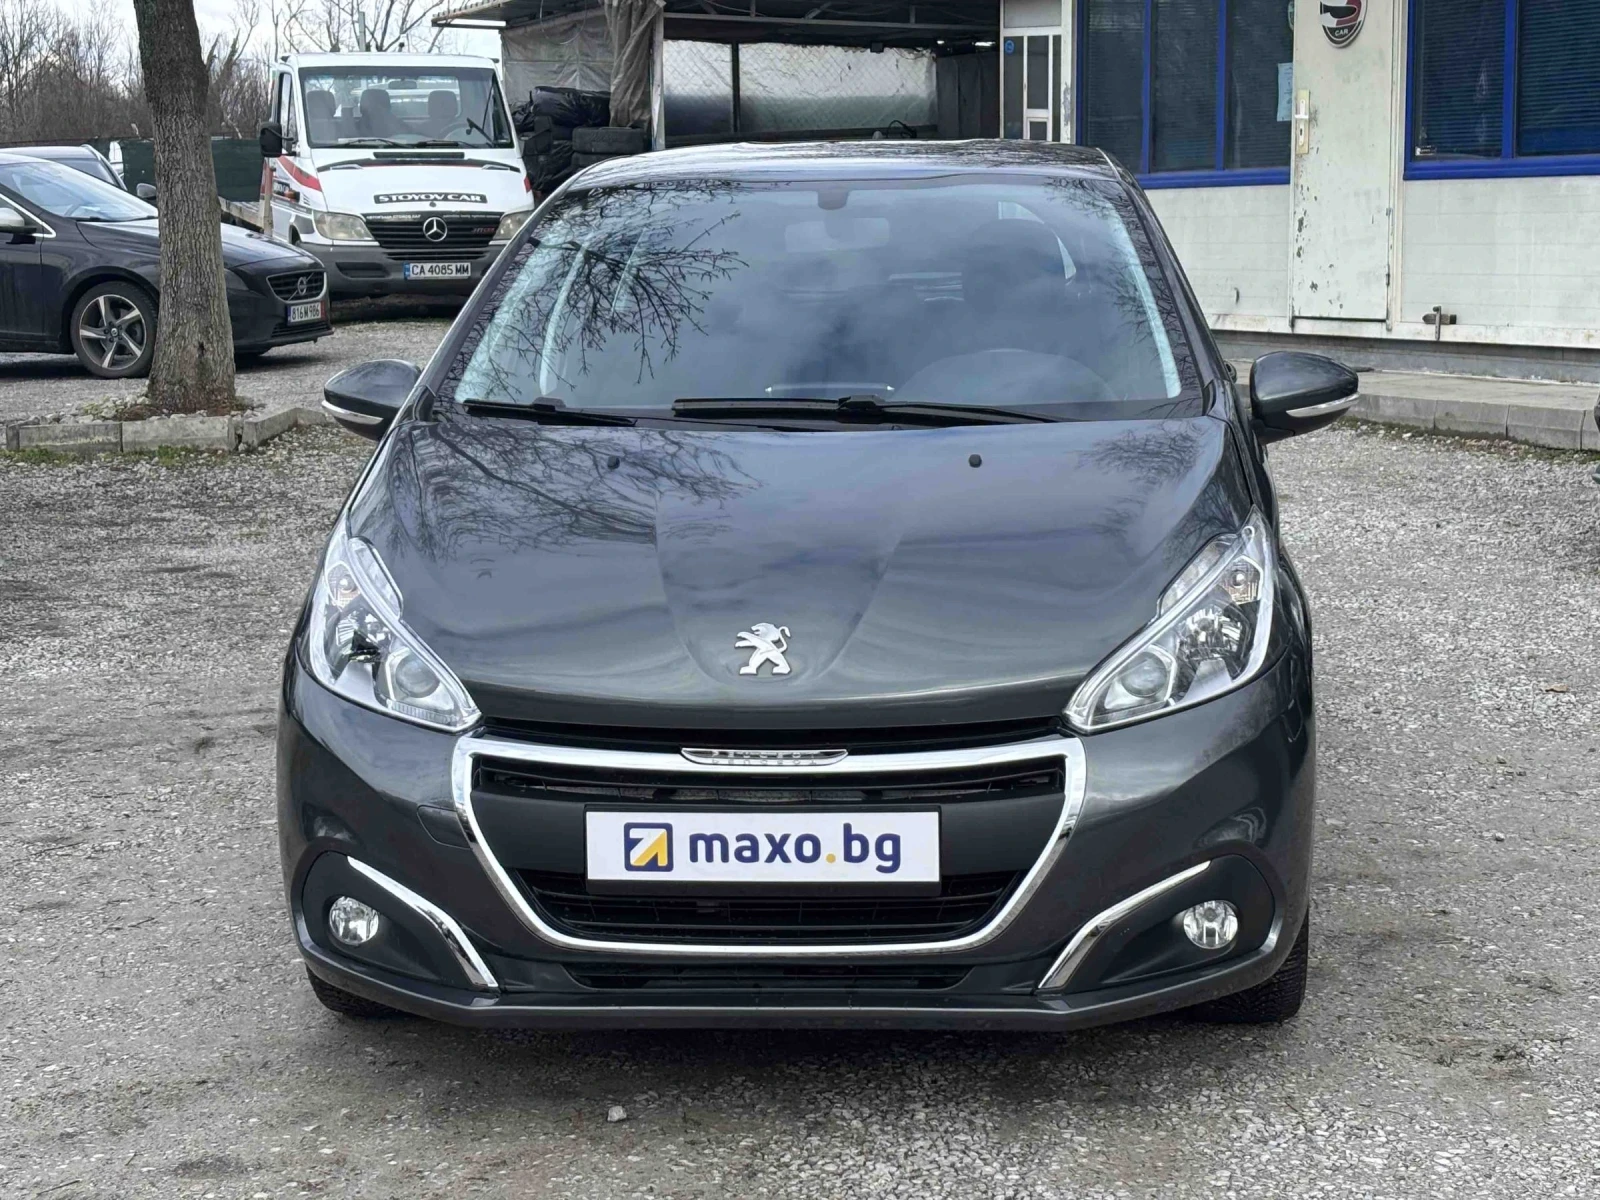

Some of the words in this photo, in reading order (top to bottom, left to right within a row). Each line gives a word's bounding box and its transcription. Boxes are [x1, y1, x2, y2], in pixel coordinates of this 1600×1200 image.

[1334, 28, 1349, 37] CAR
[379, 193, 444, 202] STOYOV
[447, 193, 482, 202] CAR
[411, 264, 425, 276] CA
[427, 264, 453, 276] 4085
[455, 264, 469, 275] MM
[689, 822, 901, 874] maxo.bg
